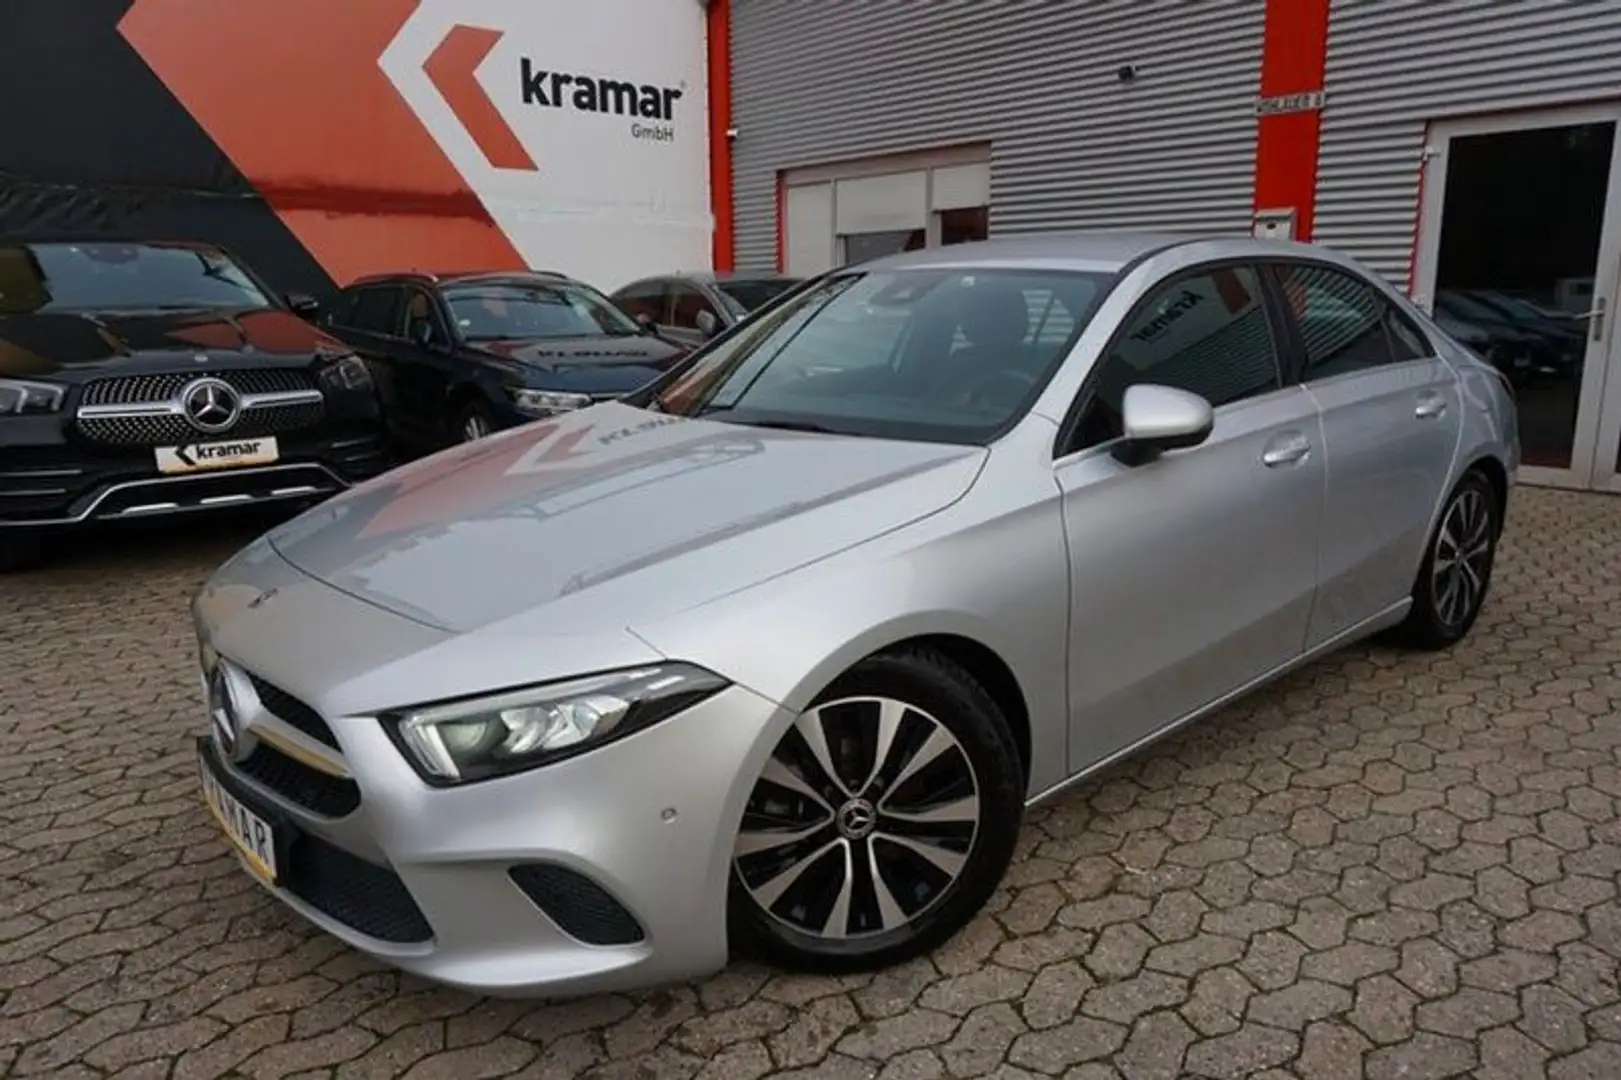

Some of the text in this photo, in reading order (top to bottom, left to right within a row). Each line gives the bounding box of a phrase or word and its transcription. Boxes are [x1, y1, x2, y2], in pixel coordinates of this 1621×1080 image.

[520, 56, 682, 120] kramar
[630, 122, 675, 142] GmbH
[196, 441, 262, 459] kramar
